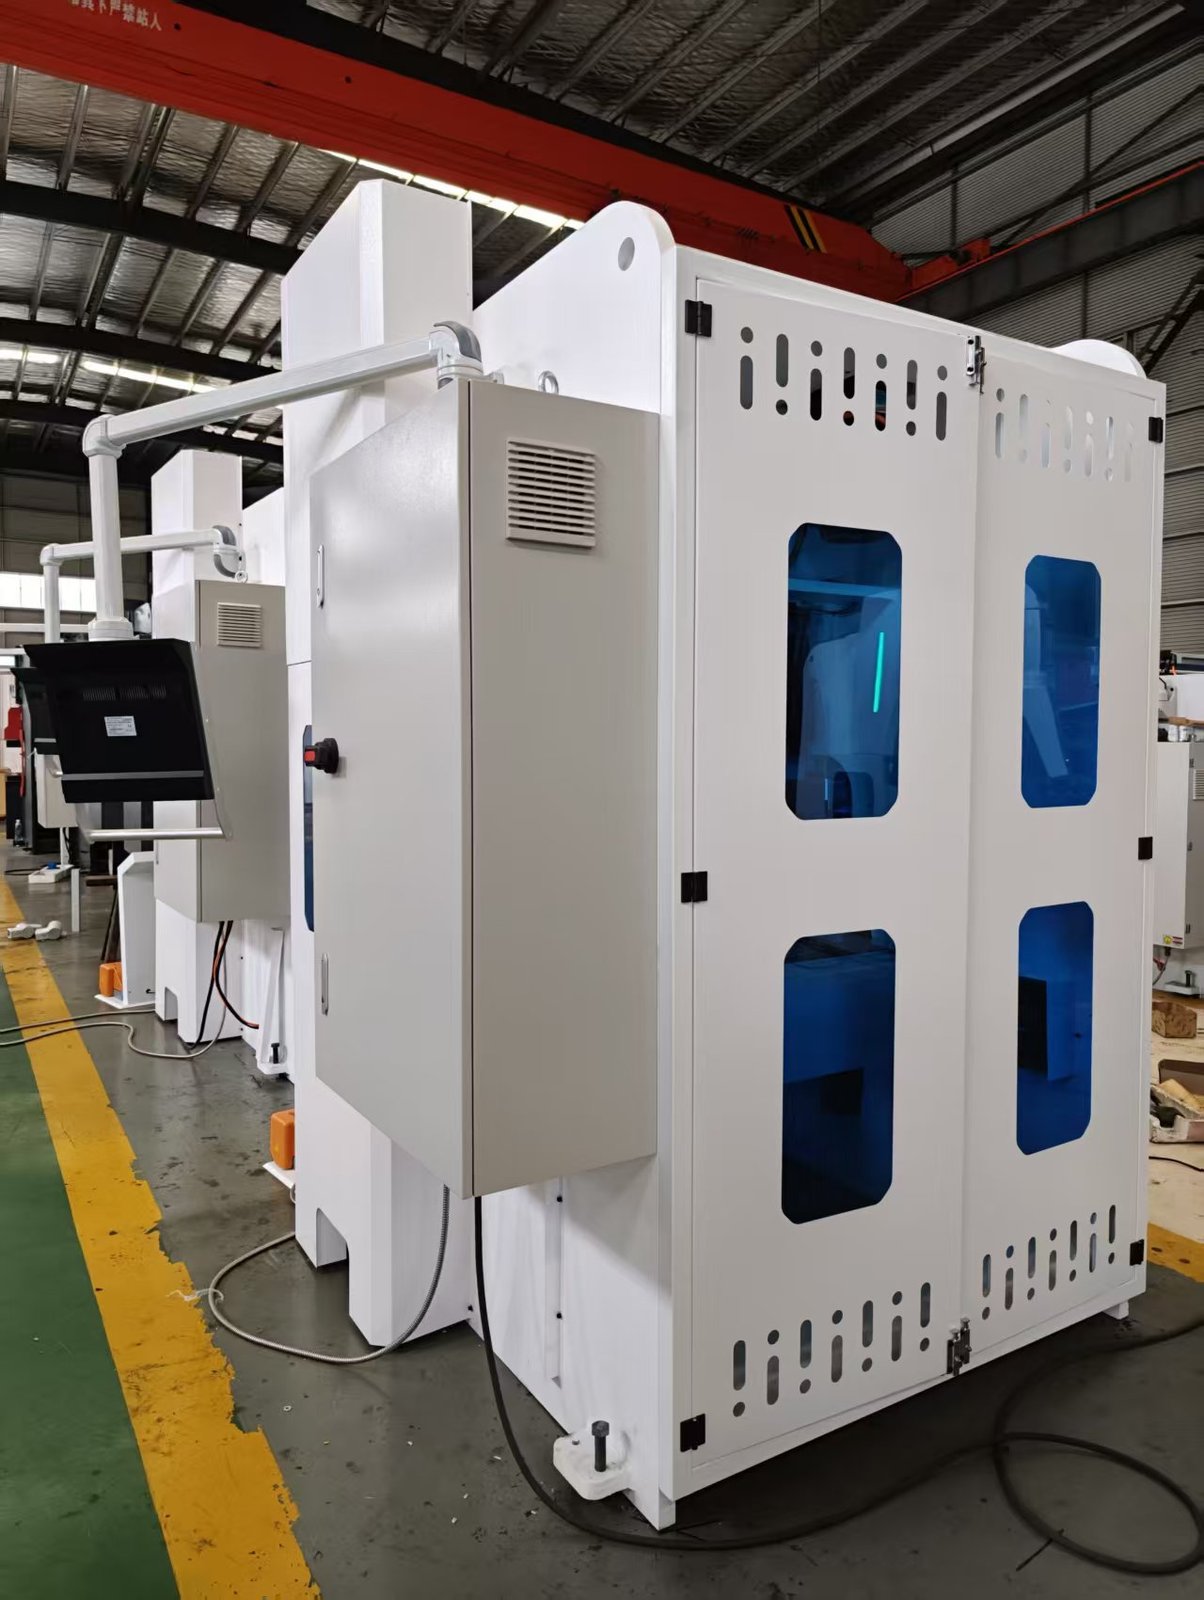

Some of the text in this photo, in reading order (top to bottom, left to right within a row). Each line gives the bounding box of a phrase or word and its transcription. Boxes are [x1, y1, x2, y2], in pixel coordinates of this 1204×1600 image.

[71, 0, 162, 31] 具下严禁站人
